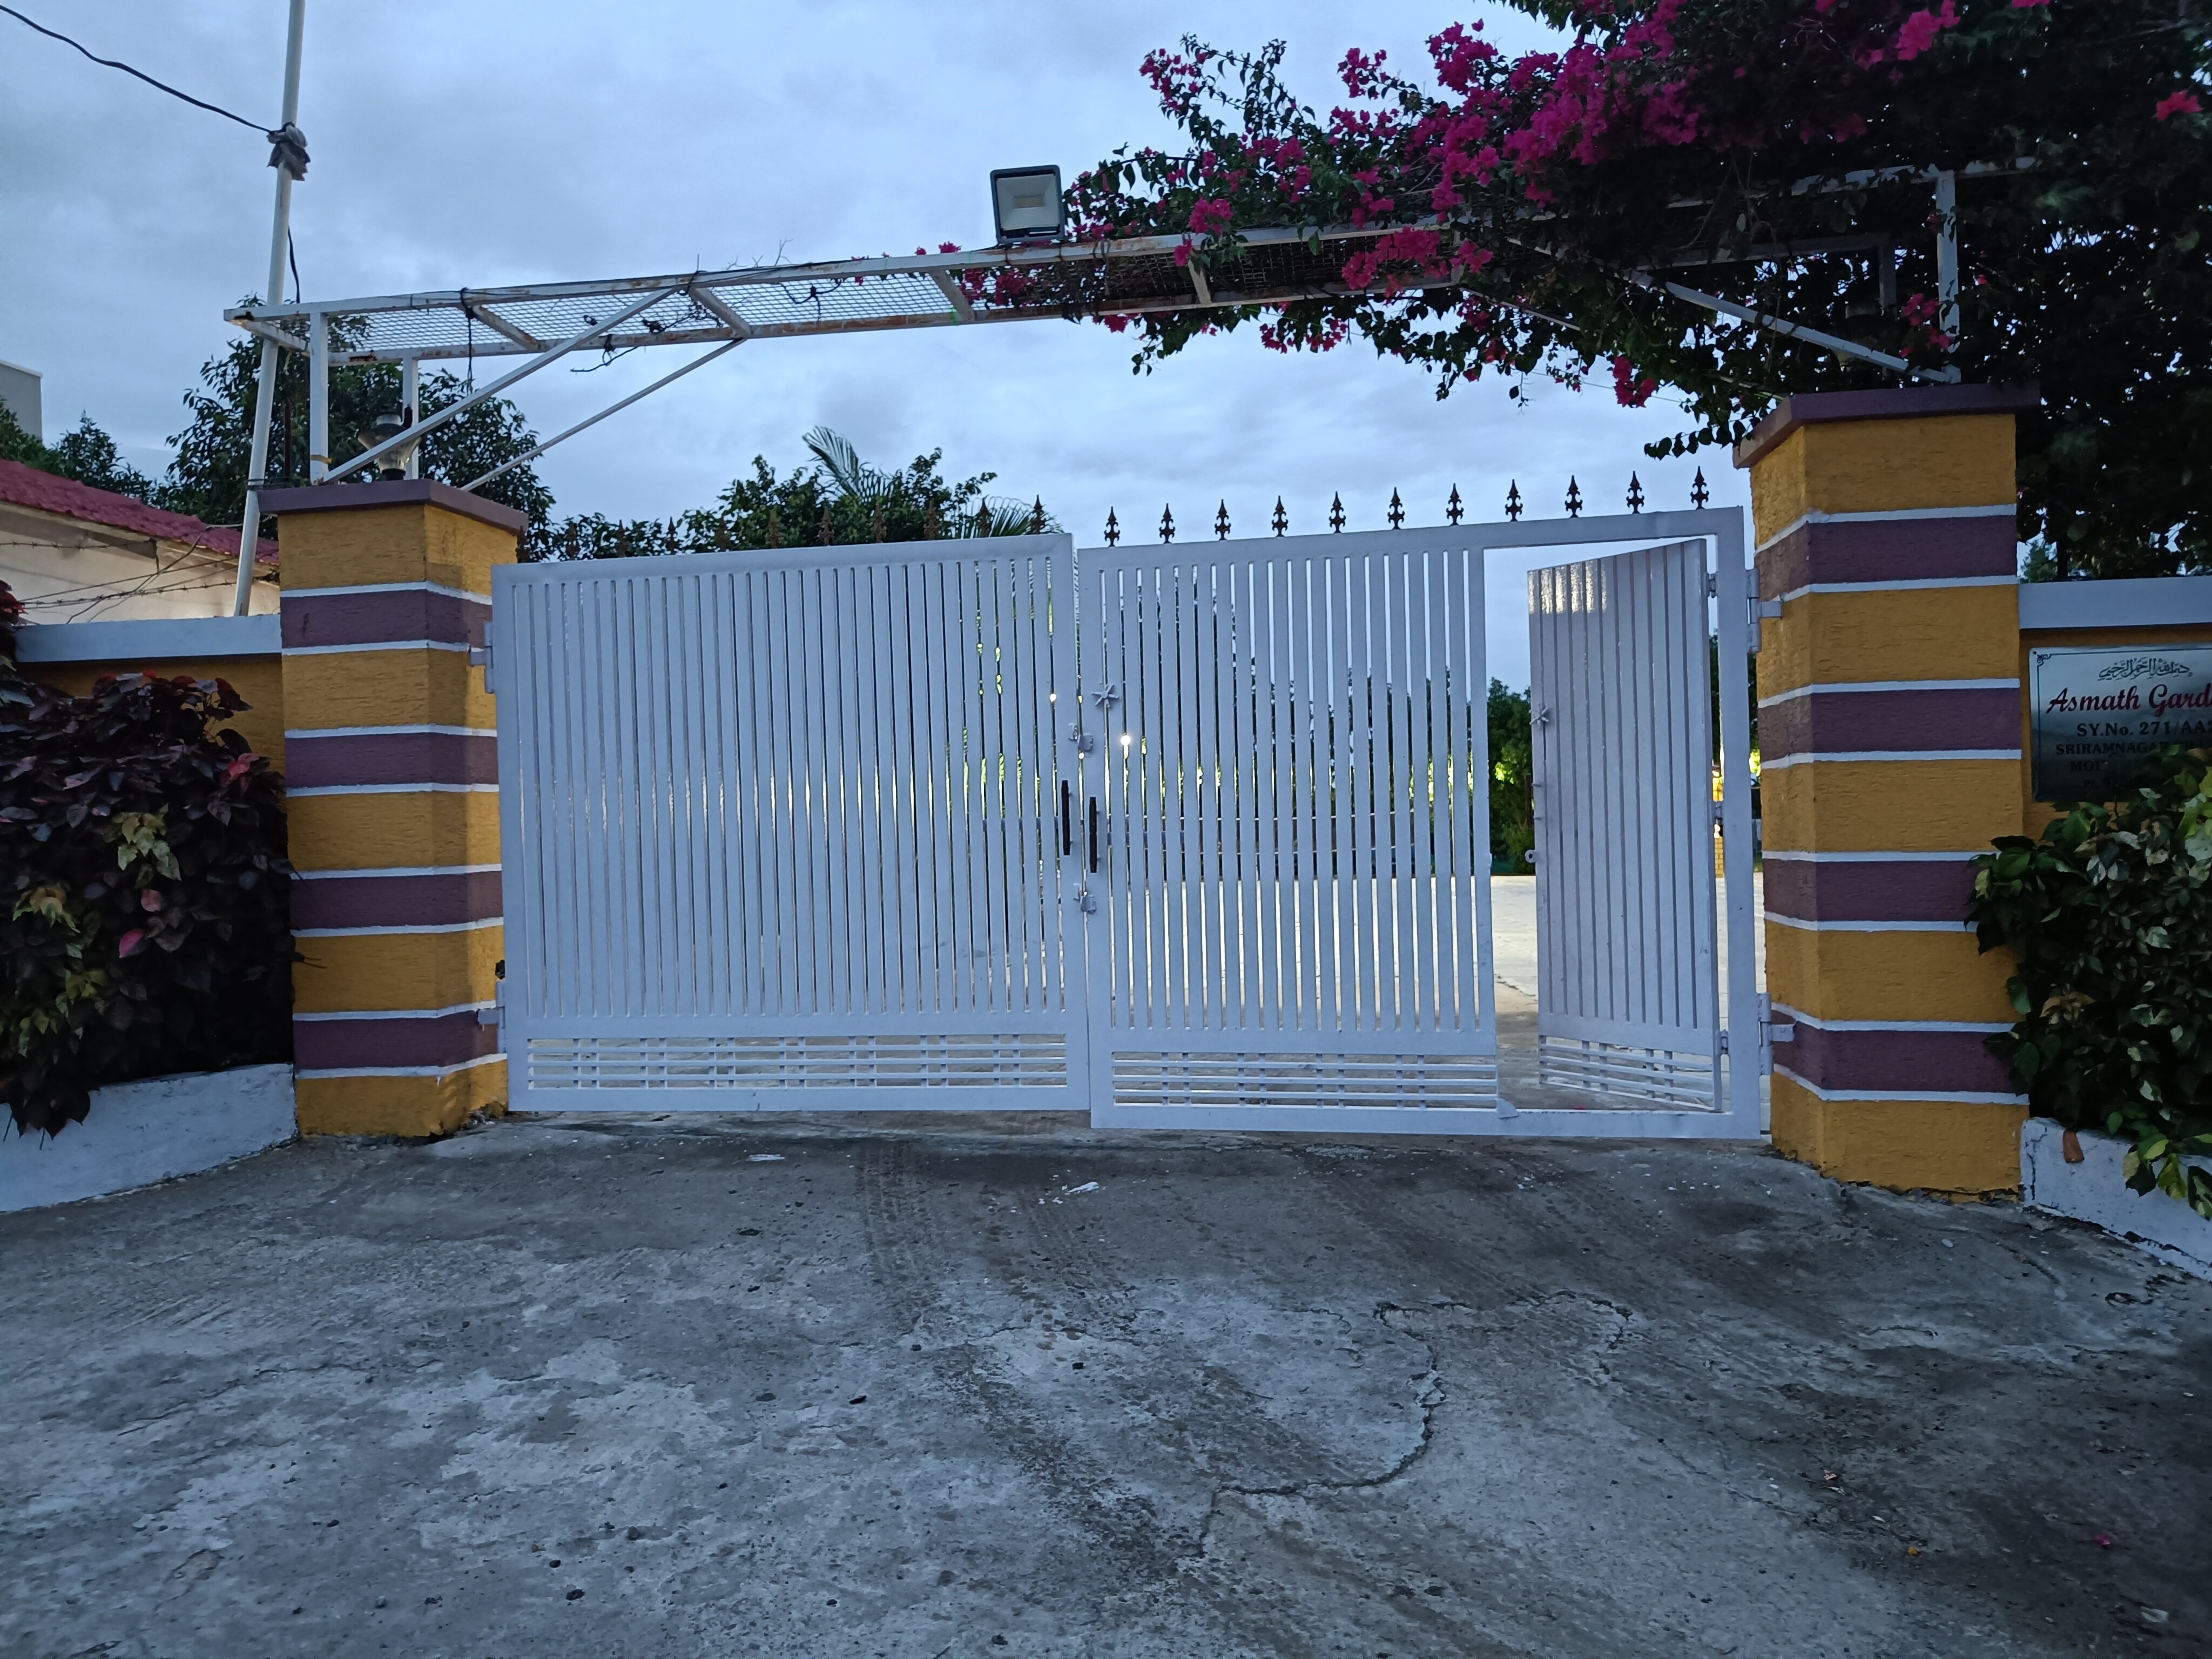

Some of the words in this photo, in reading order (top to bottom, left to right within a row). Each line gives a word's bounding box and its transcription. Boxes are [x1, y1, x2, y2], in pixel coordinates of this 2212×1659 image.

[2046, 685, 2141, 713] Asmath
[2148, 682, 2212, 717] Gard
[2076, 722, 2134, 737] SY.No.
